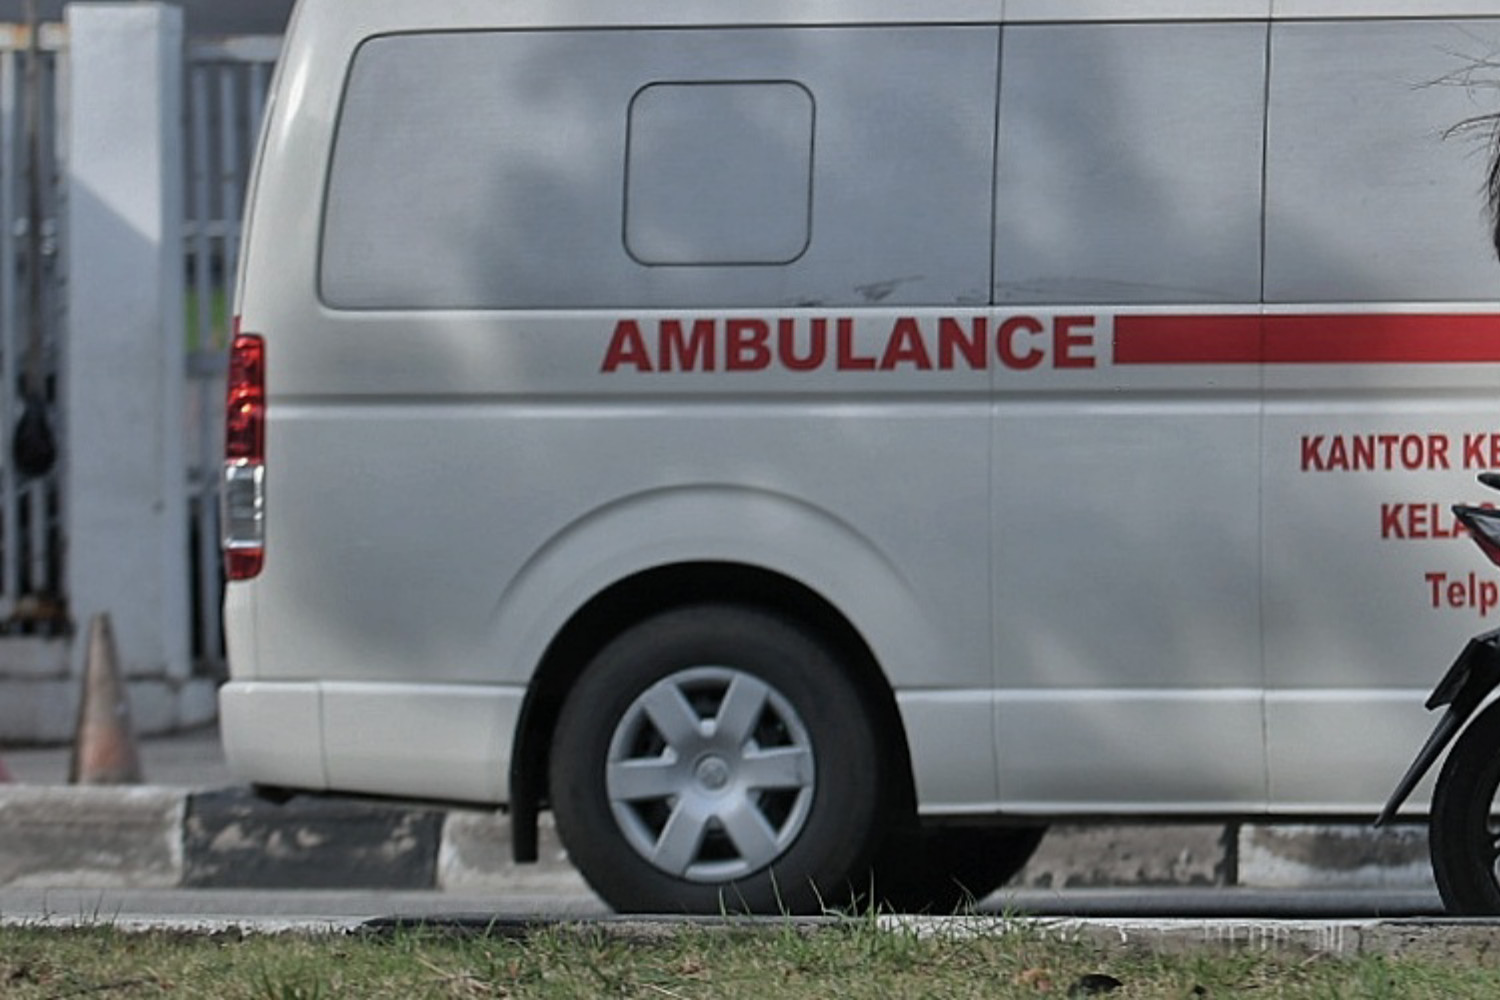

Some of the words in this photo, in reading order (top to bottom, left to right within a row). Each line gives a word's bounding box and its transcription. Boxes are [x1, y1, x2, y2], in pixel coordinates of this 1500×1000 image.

[600, 315, 1097, 372] AMBULANCE
[1301, 434, 1451, 471] KANTOR
[1424, 572, 1499, 617] Telp
